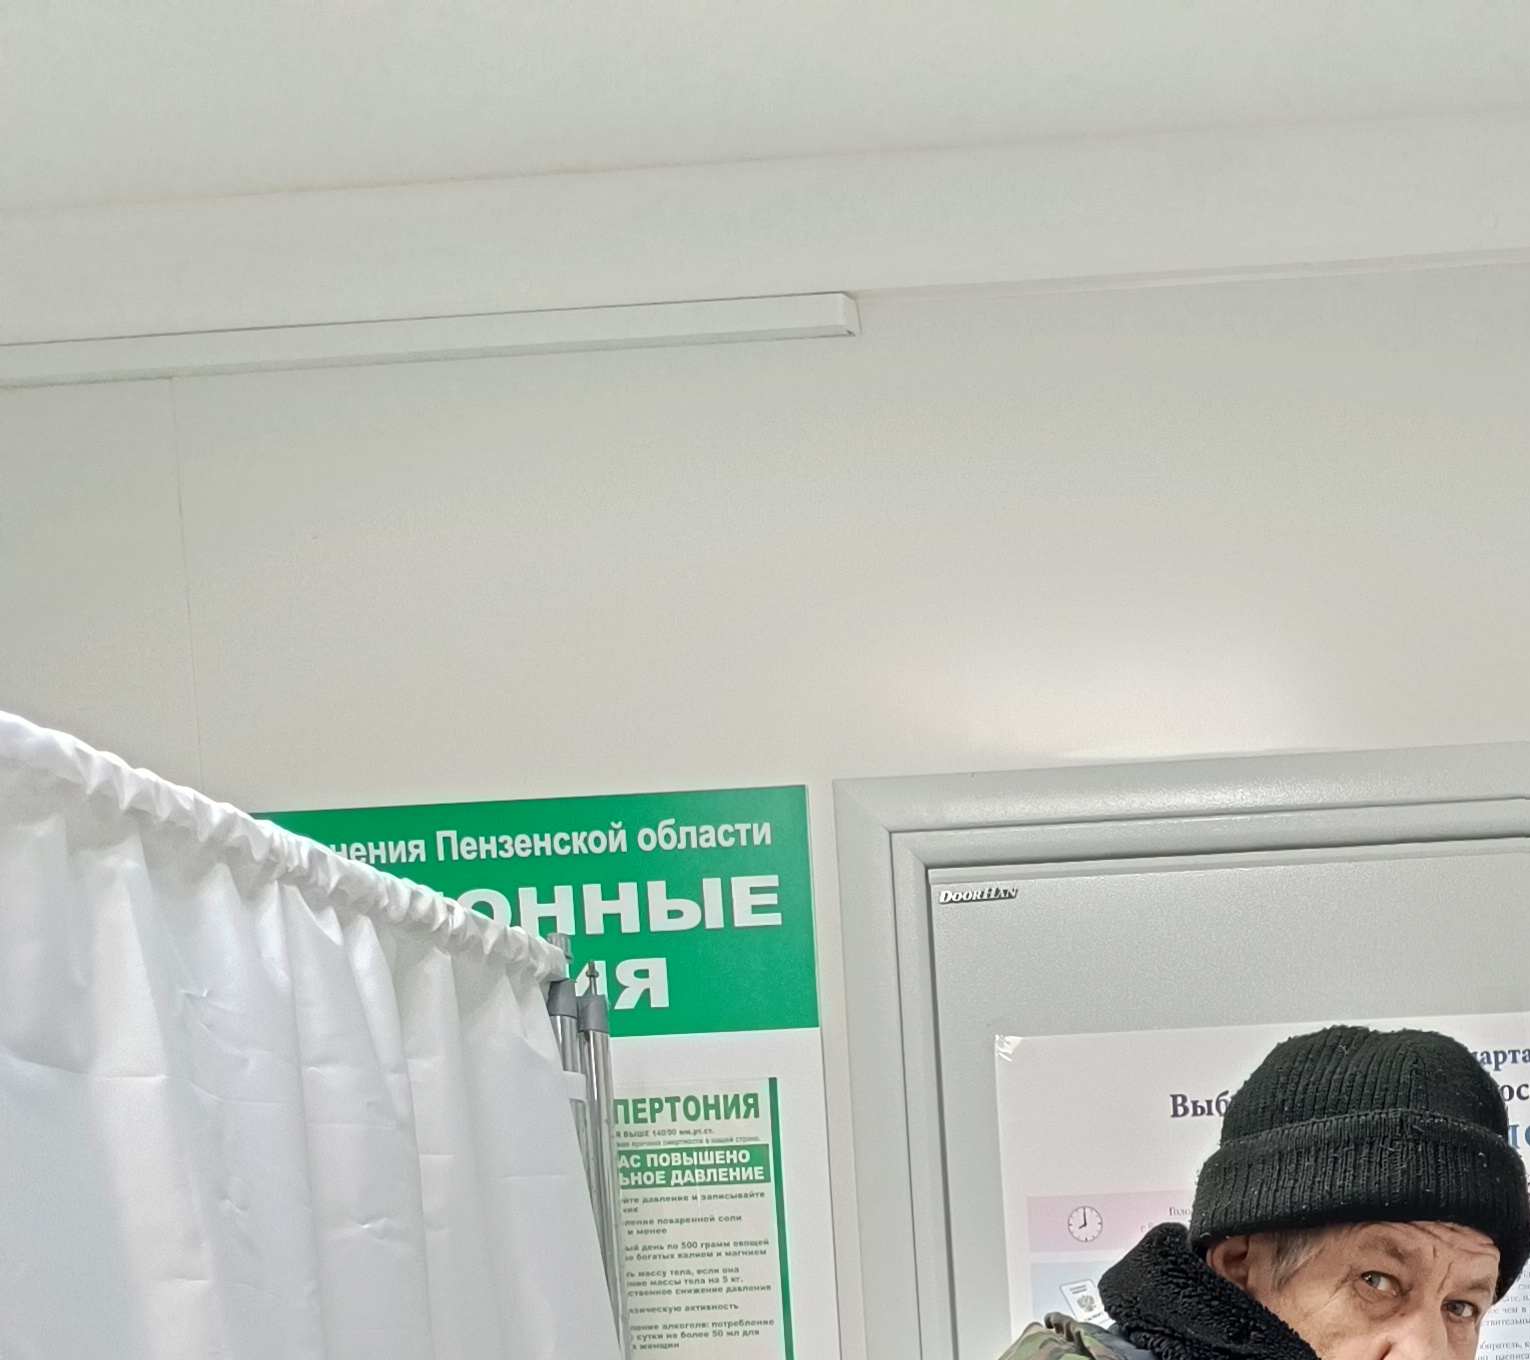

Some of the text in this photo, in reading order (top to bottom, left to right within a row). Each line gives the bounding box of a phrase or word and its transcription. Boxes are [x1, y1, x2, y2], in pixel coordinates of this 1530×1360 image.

[436, 821, 628, 861] Пензенской
[638, 818, 772, 852] области
[624, 1130, 650, 1138] ВЫШЕ
[647, 1150, 750, 1167] ПОВЫШЕНО
[671, 1166, 764, 1185] ДАВЛЕНИЕ
[642, 1191, 765, 1203] давление записывайте
[658, 1215, 715, 1225] поваренной
[701, 1241, 730, 1249] грамм
[712, 1319, 774, 1327] потребление
